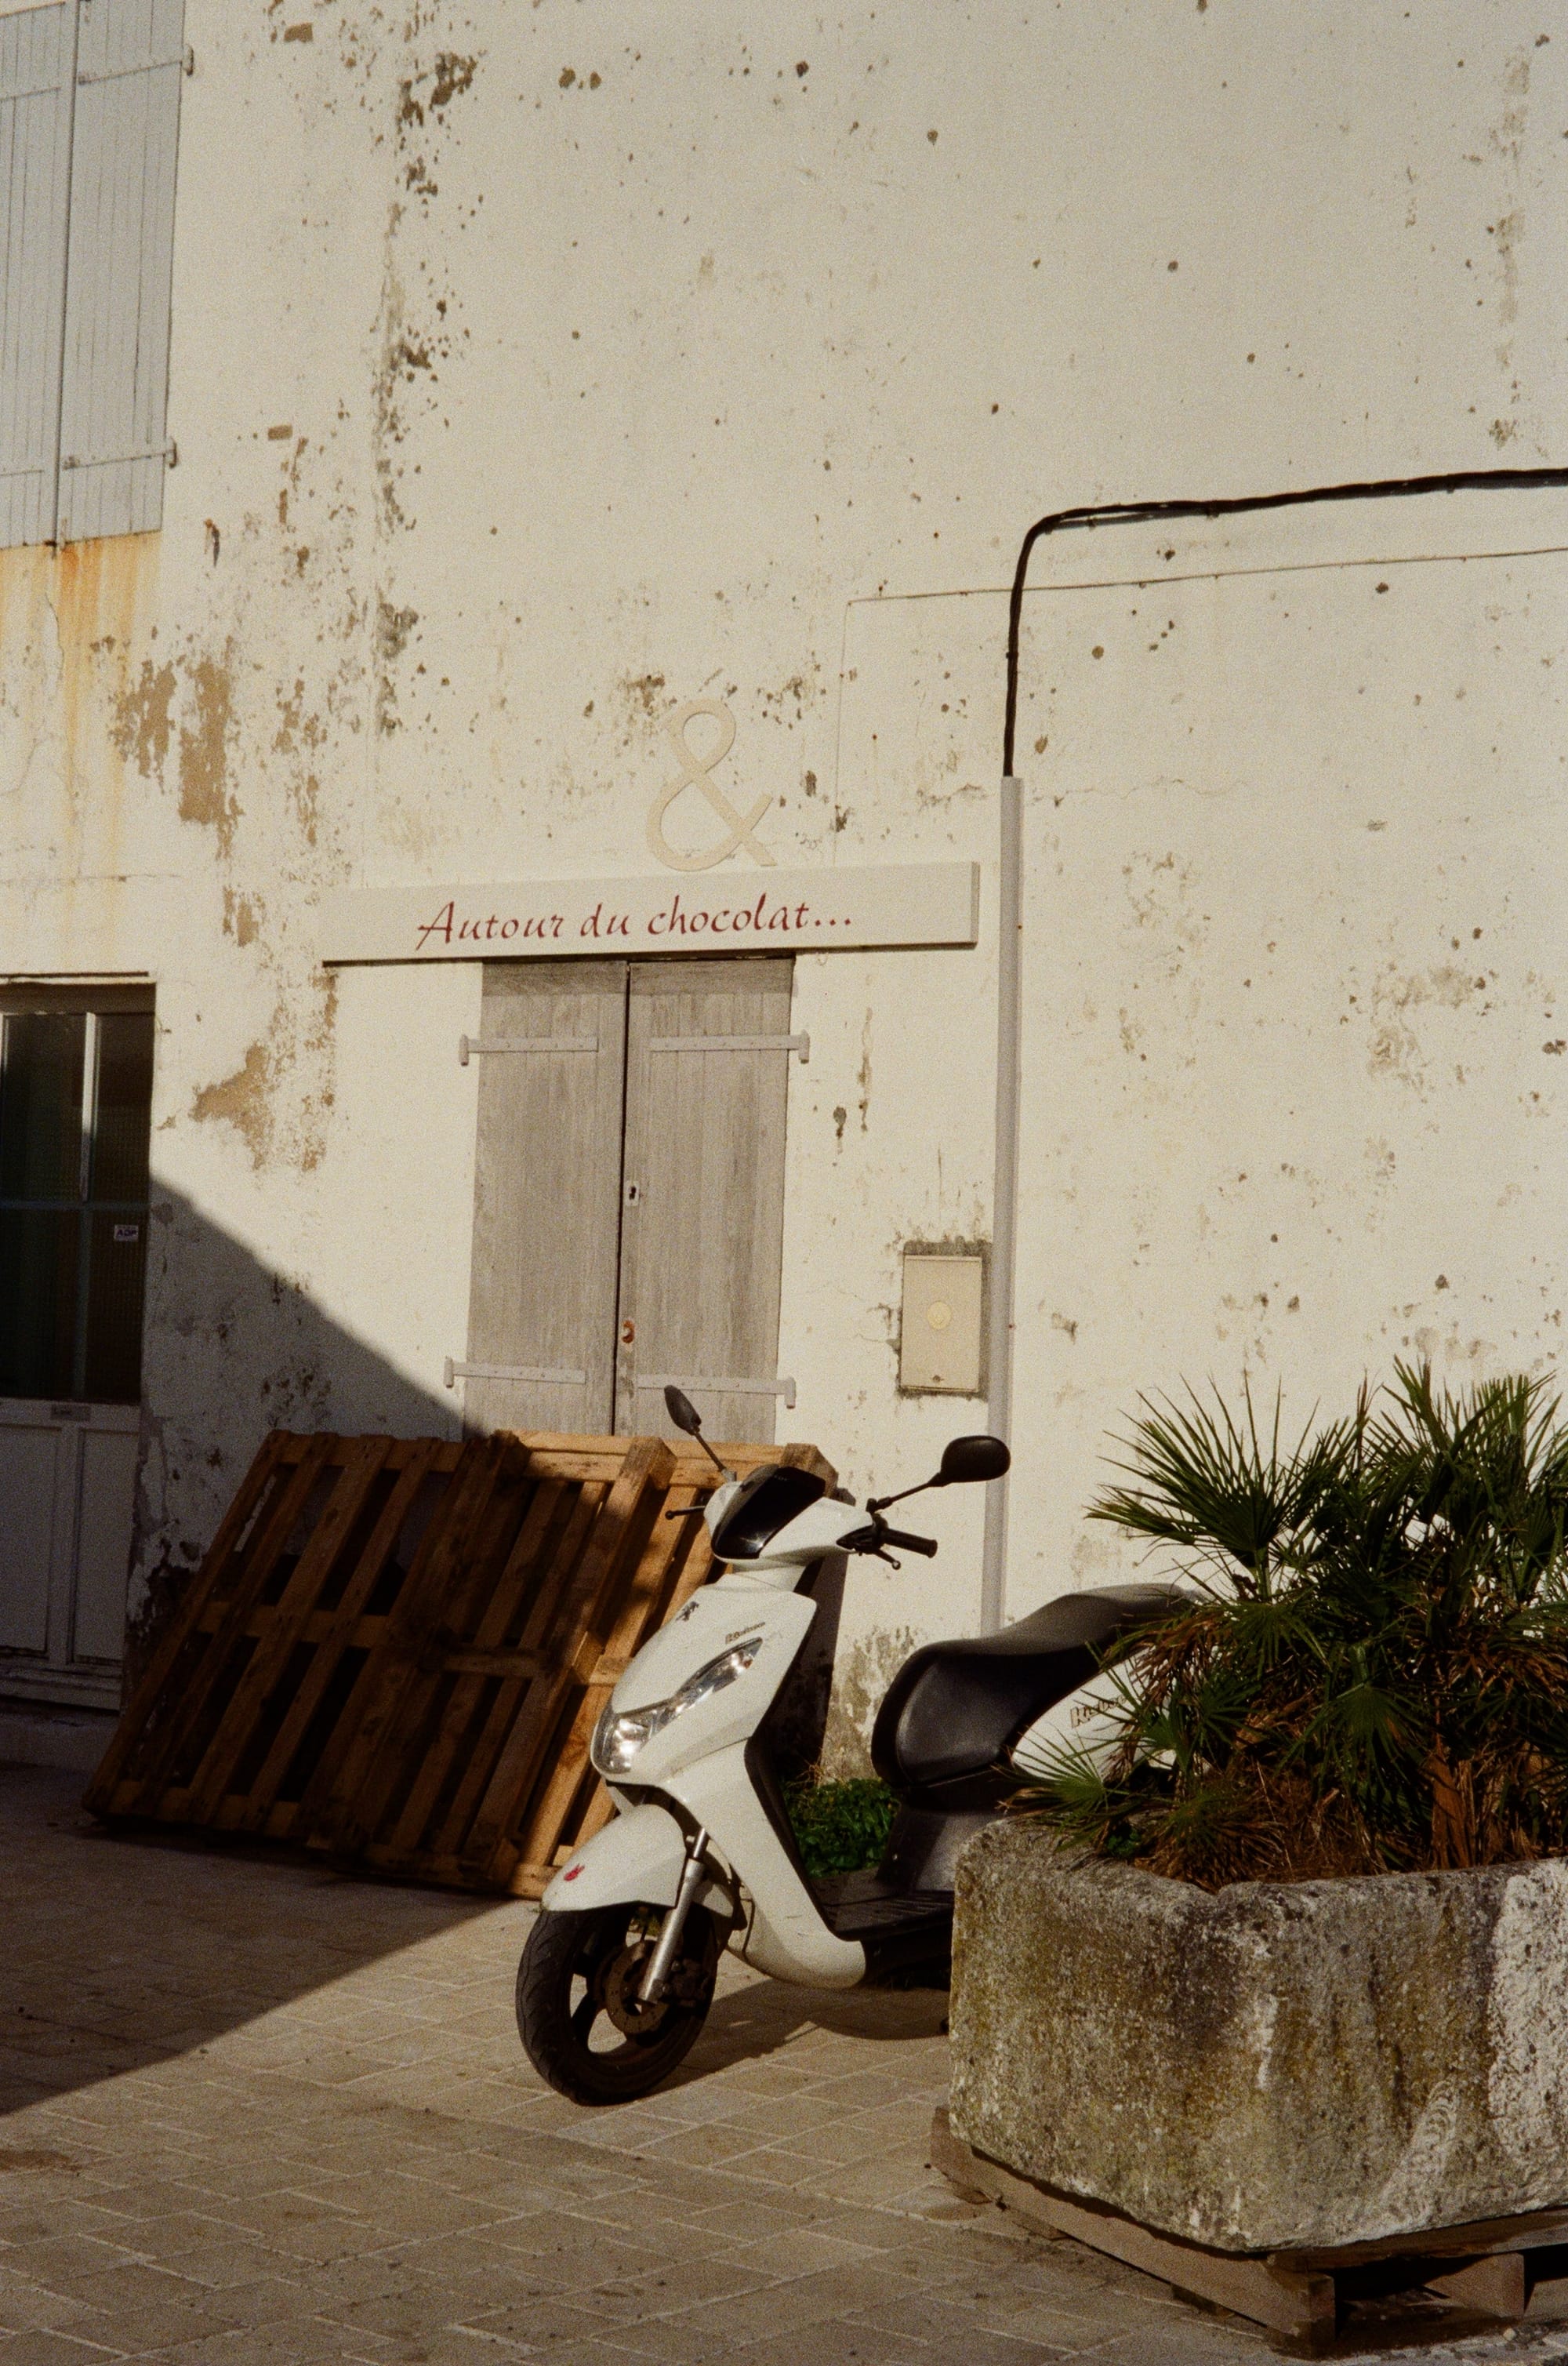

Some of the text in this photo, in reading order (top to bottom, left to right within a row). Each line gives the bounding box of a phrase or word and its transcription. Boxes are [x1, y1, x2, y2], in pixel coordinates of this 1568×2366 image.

[646, 699, 778, 872] &
[416, 892, 851, 950] Autour du chocolat...
